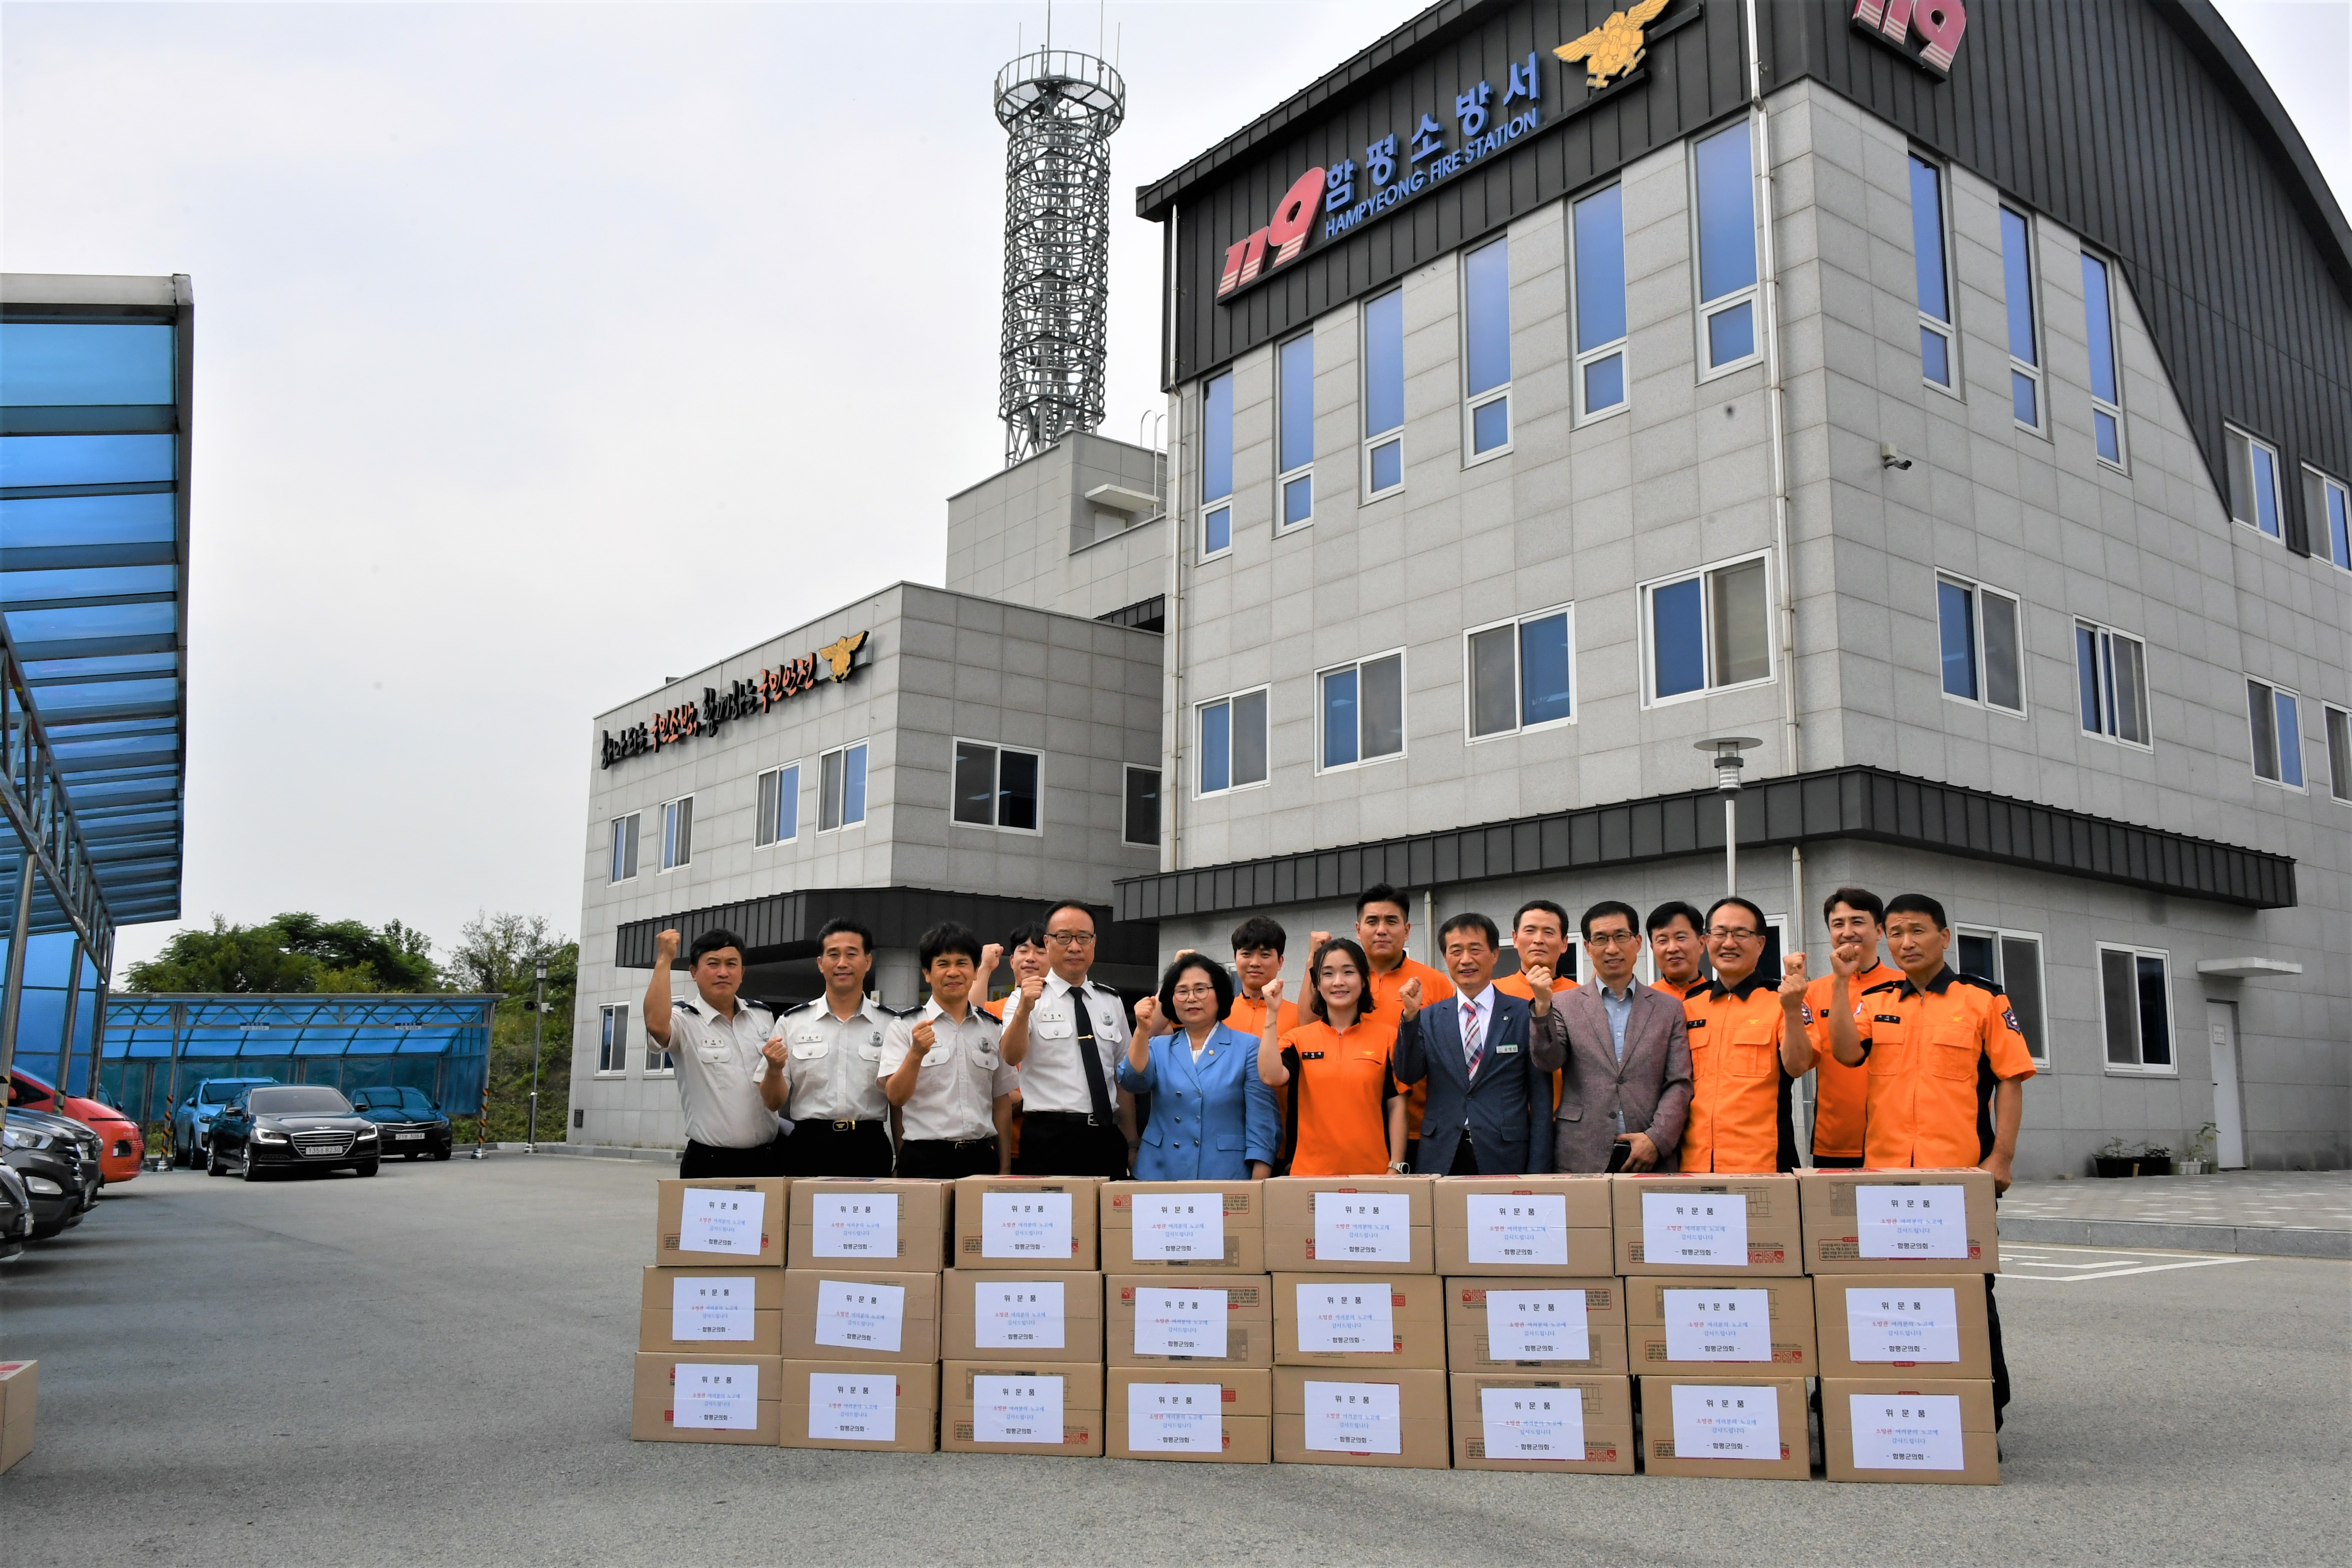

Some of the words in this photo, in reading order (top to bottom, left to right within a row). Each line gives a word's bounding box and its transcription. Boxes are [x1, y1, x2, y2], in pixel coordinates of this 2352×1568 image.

[1216, 166, 1327, 297] 119
[1325, 52, 1541, 212] 함평소방서
[1325, 169, 1424, 238] HAMPYEONG
[1430, 148, 1461, 180] FIRE
[1464, 107, 1537, 163] STATION
[702, 679, 757, 738] 함께하는
[757, 652, 817, 714] 국민안전
[846, 1333, 871, 1341] 함평군의회
